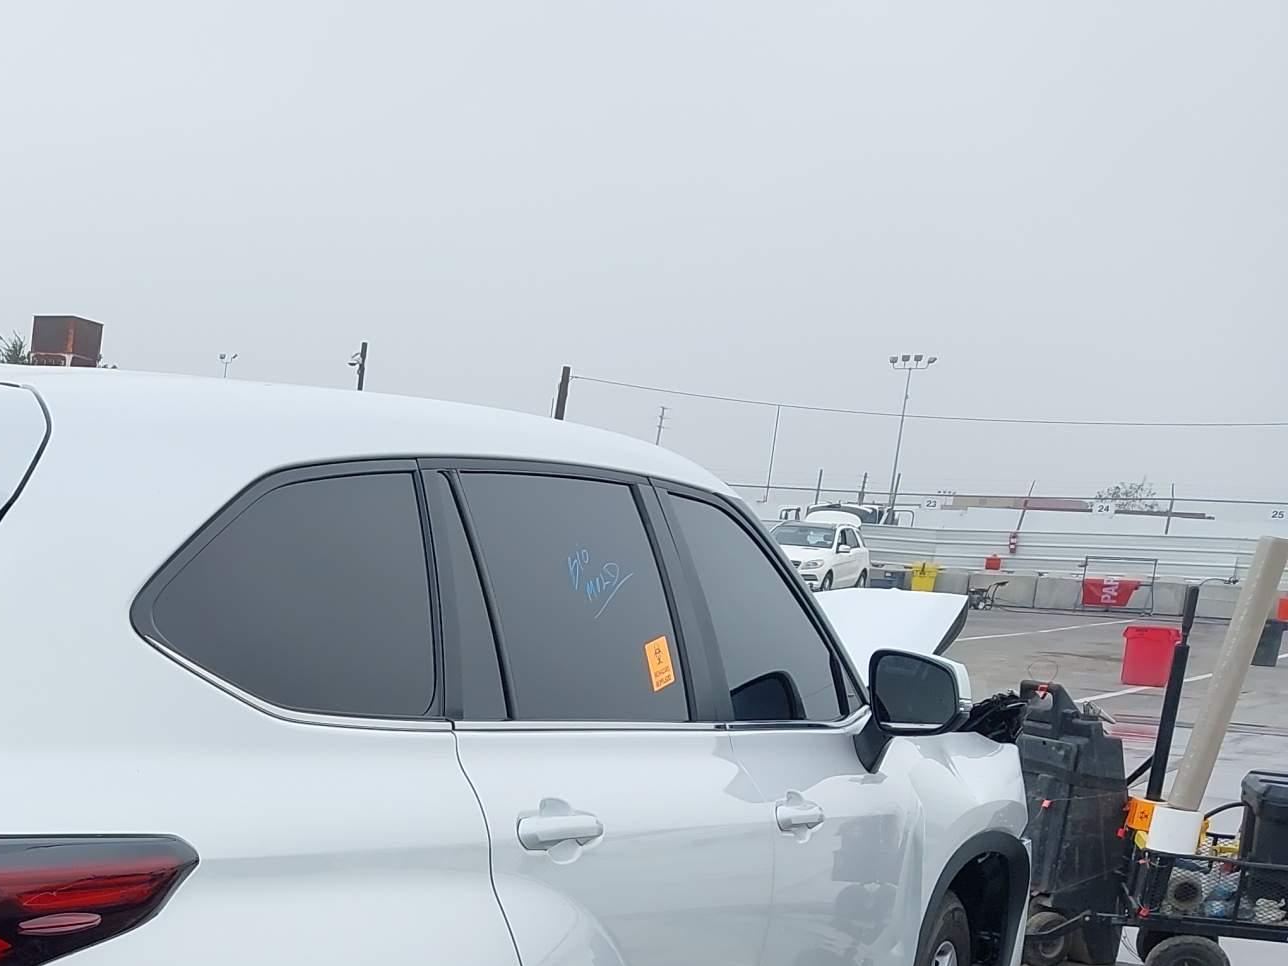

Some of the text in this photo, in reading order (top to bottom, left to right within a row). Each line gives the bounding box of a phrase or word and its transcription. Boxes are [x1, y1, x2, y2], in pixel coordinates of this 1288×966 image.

[926, 500, 937, 508] 23
[1098, 505, 1110, 513] 24
[1272, 510, 1285, 519] 25
